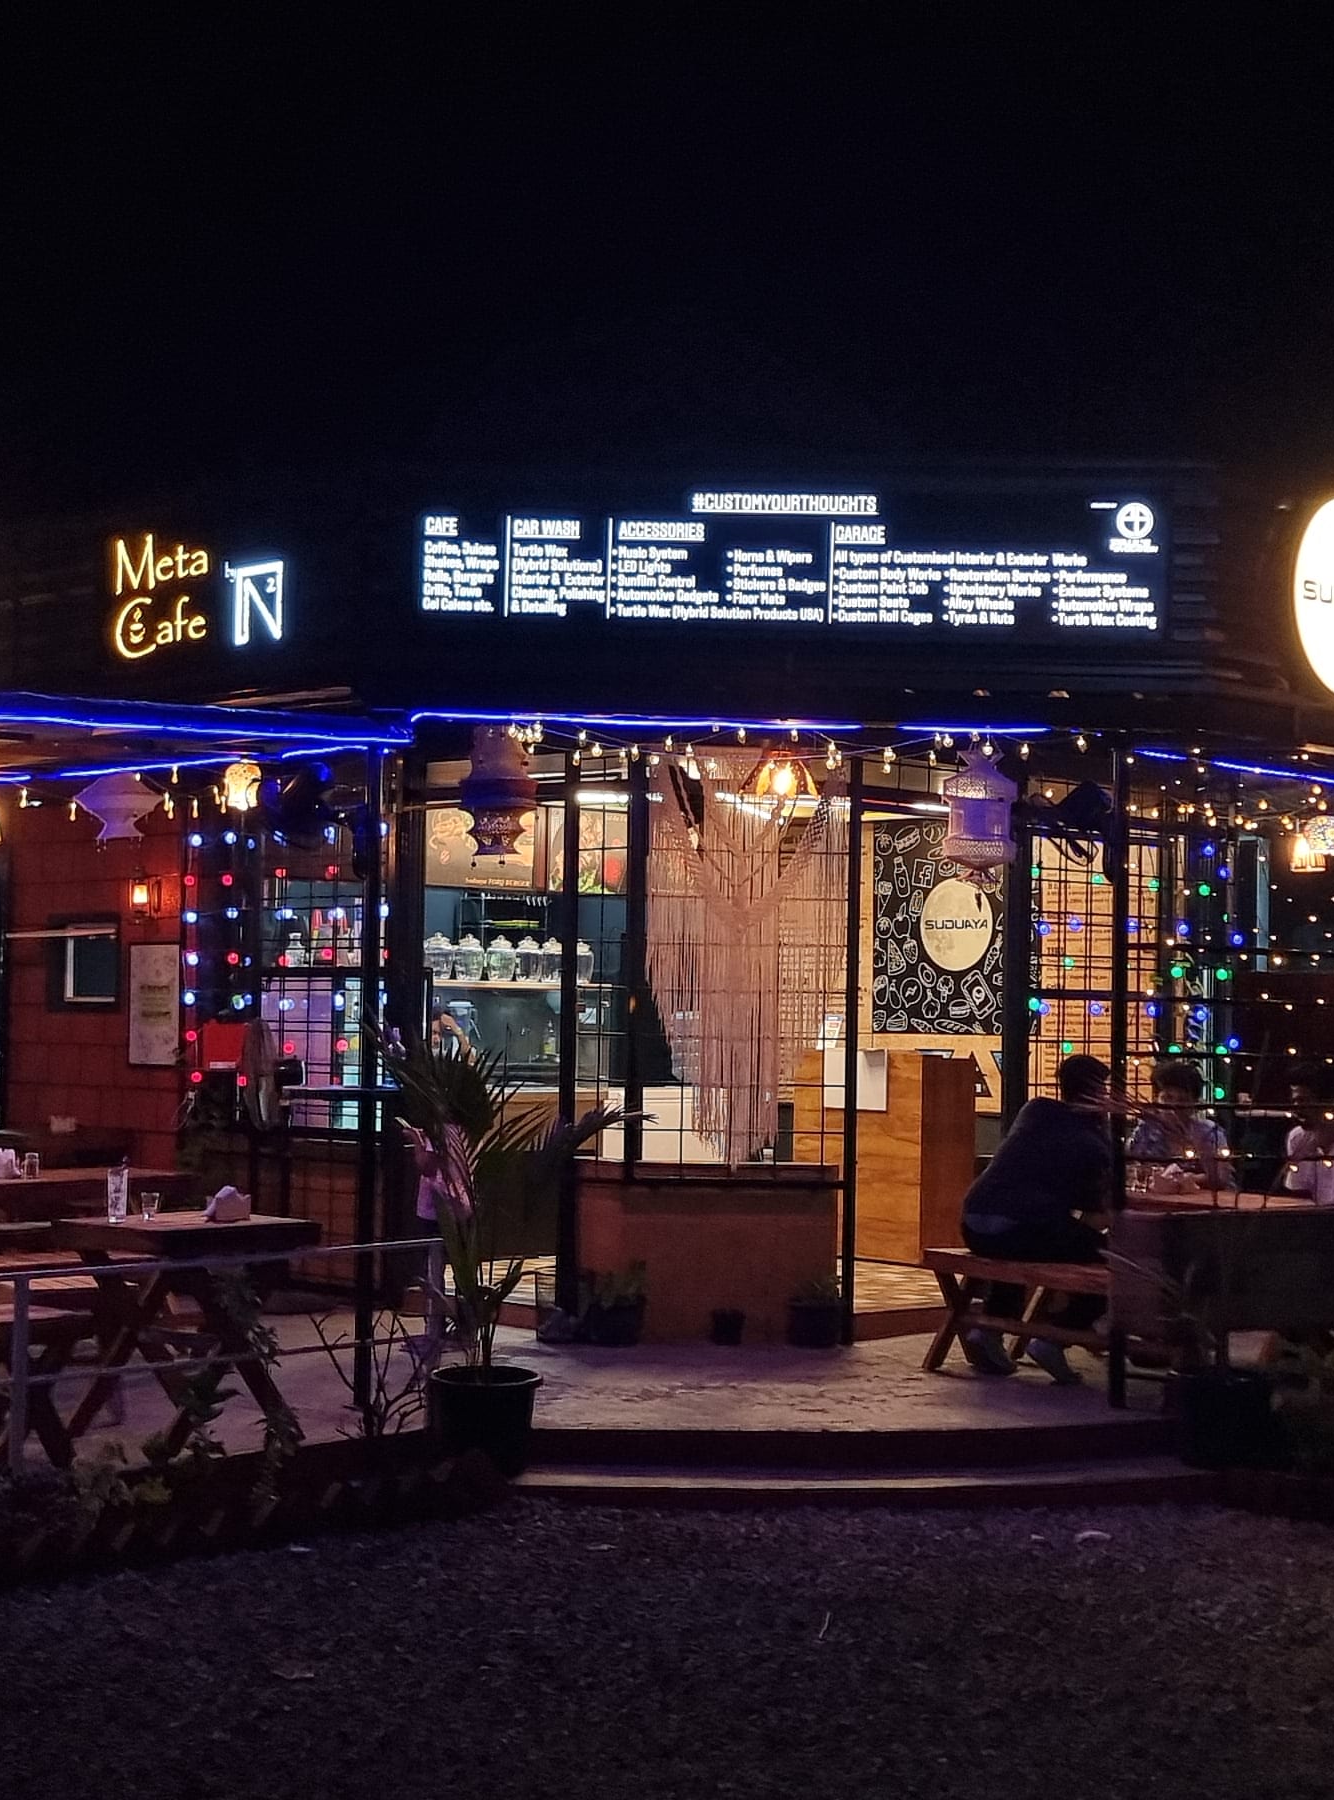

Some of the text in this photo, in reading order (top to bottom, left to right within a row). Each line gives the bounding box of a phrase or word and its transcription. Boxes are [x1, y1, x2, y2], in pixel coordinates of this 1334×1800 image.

[692, 493, 877, 512] #CUSTOMYOURTHOUGHTS
[425, 517, 458, 532] CAFE
[514, 519, 579, 536] CAR WASH
[619, 521, 704, 537] ACCESSORIES
[835, 525, 885, 541] GARAGE
[462, 542, 496, 556] Juices
[513, 543, 568, 557] Turtle Wax
[618, 546, 687, 561] Music System
[115, 533, 209, 596] Meta
[466, 557, 499, 572] Wraps
[734, 549, 812, 566] Horns & Wipers
[835, 550, 1087, 566] All types of Customised Interior & Exterior Works
[512, 558, 602, 573] (Hybrid Solutions)
[618, 560, 671, 575] LED Lights
[734, 564, 782, 576] Perfumes
[512, 572, 605, 586] Interior & Exterior
[617, 574, 695, 588] Sunfilm Control
[839, 567, 941, 582] Custom Body Works
[950, 568, 1010, 582] Restoration
[733, 577, 826, 595] Stickers & Badges
[839, 581, 928, 594] Custom Paint Job
[949, 583, 1041, 599] Upholstery Works
[1102, 585, 1149, 600] Systems
[559, 587, 605, 603] Polishing
[617, 588, 718, 605] Automotive Gadgets
[733, 591, 785, 605] Floor Mats
[838, 595, 878, 608] Custom
[511, 600, 566, 616] & Detailing
[948, 597, 1014, 612] Alloy Wheels
[1058, 599, 1154, 614] Automotive Wraps
[617, 604, 646, 617] Turtle
[648, 604, 670, 617] Wax
[711, 606, 751, 619] Solution
[753, 607, 798, 620] Products
[800, 608, 823, 623] USA)
[838, 609, 932, 625] Custom Roll Cages
[948, 611, 1014, 626] Tyres & Nuts
[1058, 613, 1157, 629] Turtle Wax Coating
[116, 596, 207, 659] Cafe
[924, 918, 988, 930] SUDUAYA
